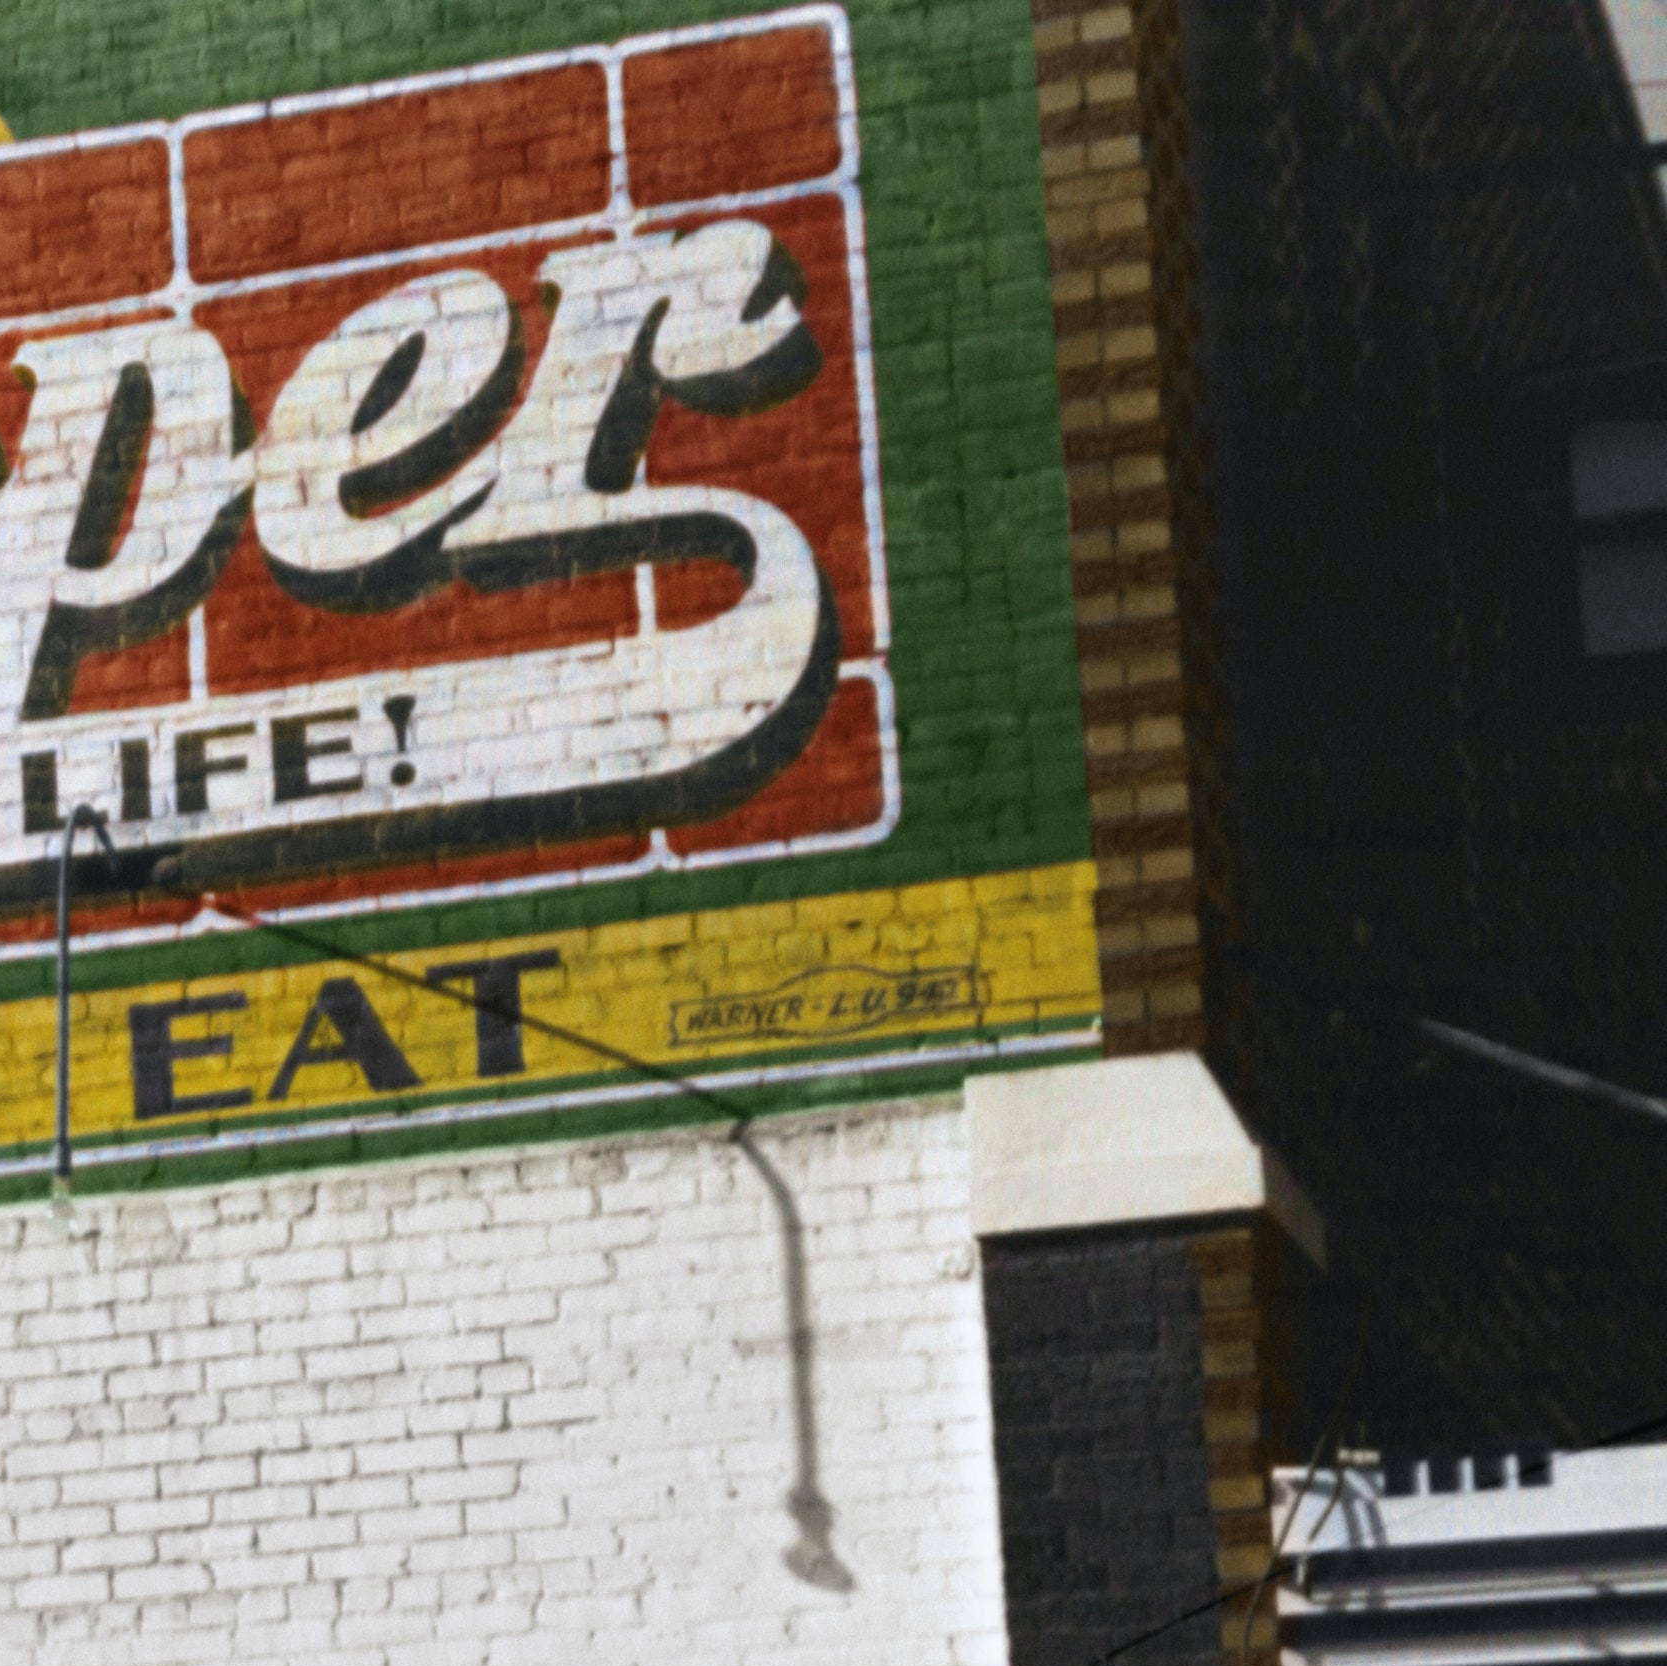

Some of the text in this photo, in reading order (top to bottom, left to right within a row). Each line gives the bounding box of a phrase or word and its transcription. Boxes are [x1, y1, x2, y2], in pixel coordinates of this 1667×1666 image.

[21, 696, 420, 835] LIFE!
[128, 950, 562, 1120] EAT
[685, 997, 804, 1032] WARNER
